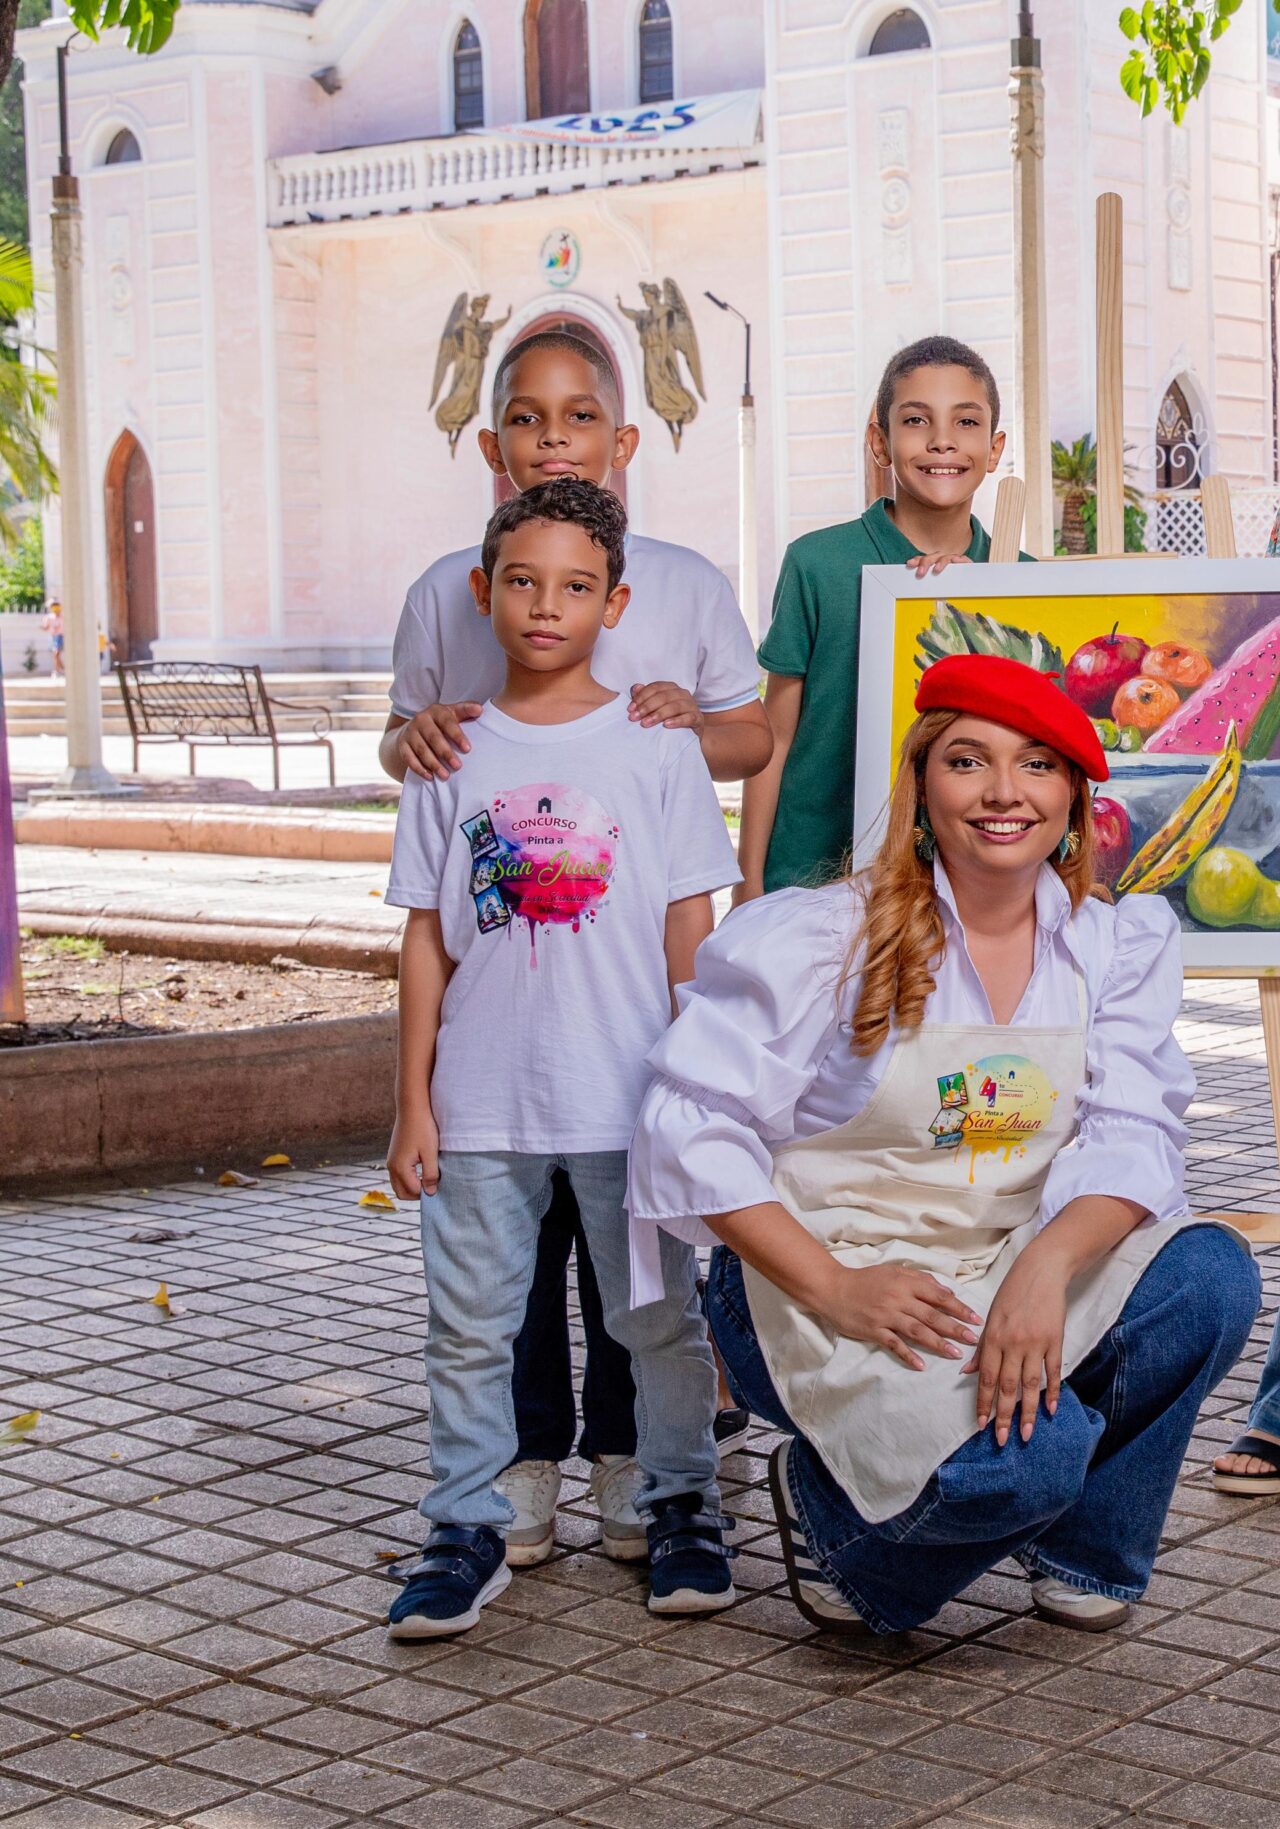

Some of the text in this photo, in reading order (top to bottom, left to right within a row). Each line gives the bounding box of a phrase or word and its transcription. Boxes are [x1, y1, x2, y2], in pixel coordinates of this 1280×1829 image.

[511, 817, 578, 832] CONCURSO
[527, 836, 564, 845] Pinta a
[490, 851, 534, 882] San
[538, 849, 608, 887] Juan
[979, 1076, 997, 1108] 4
[962, 1110, 1042, 1134] San Juan
